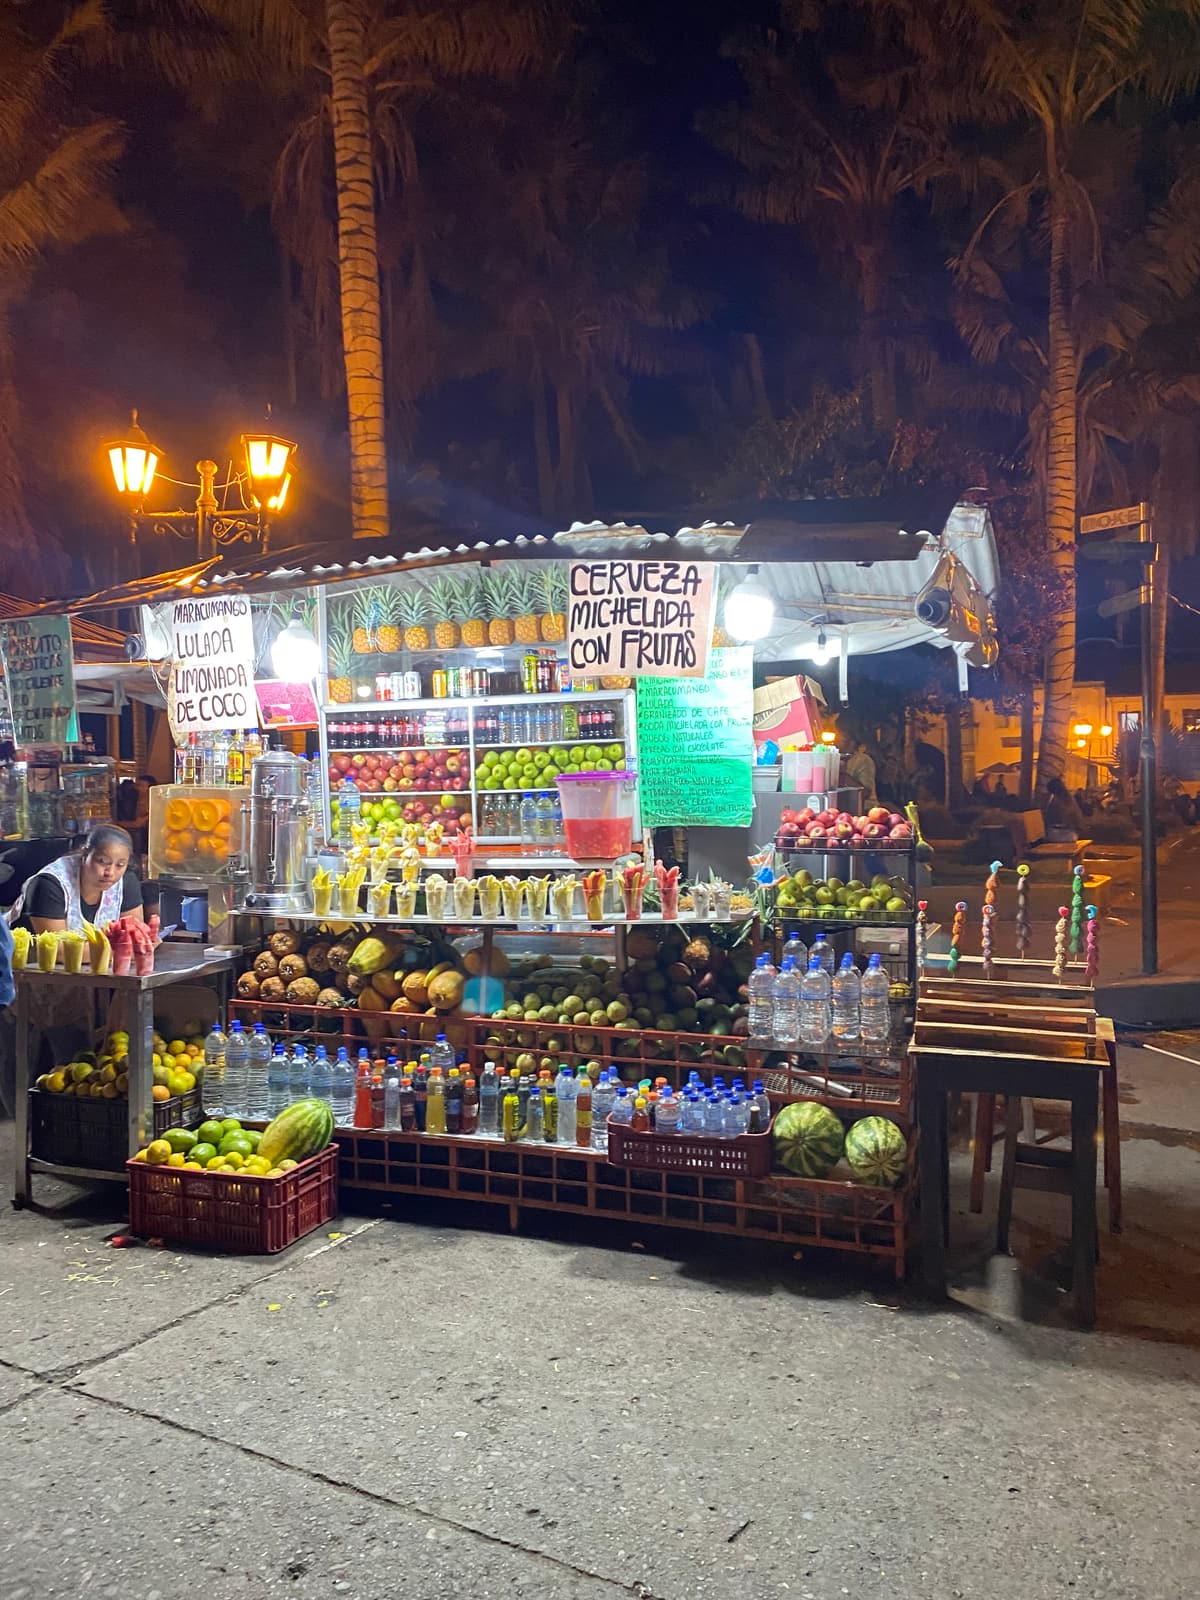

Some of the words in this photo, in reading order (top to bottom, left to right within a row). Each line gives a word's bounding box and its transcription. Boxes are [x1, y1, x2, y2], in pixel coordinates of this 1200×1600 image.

[570, 562, 702, 597] CERVEZA
[173, 602, 248, 624] MARACUMANGO
[570, 597, 694, 632] MICHELADA
[176, 628, 234, 659] LULADA
[571, 633, 611, 669] CON
[620, 629, 696, 669] FRUTAS
[175, 664, 248, 694] LIMONADA
[645, 684, 710, 697] MARACUMANGO
[177, 702, 195, 723] DE
[199, 693, 247, 717] COCO
[692, 708, 703, 717] DE
[672, 731, 714, 743] NATURALES
[688, 742, 725, 753] CHOCOLATE
